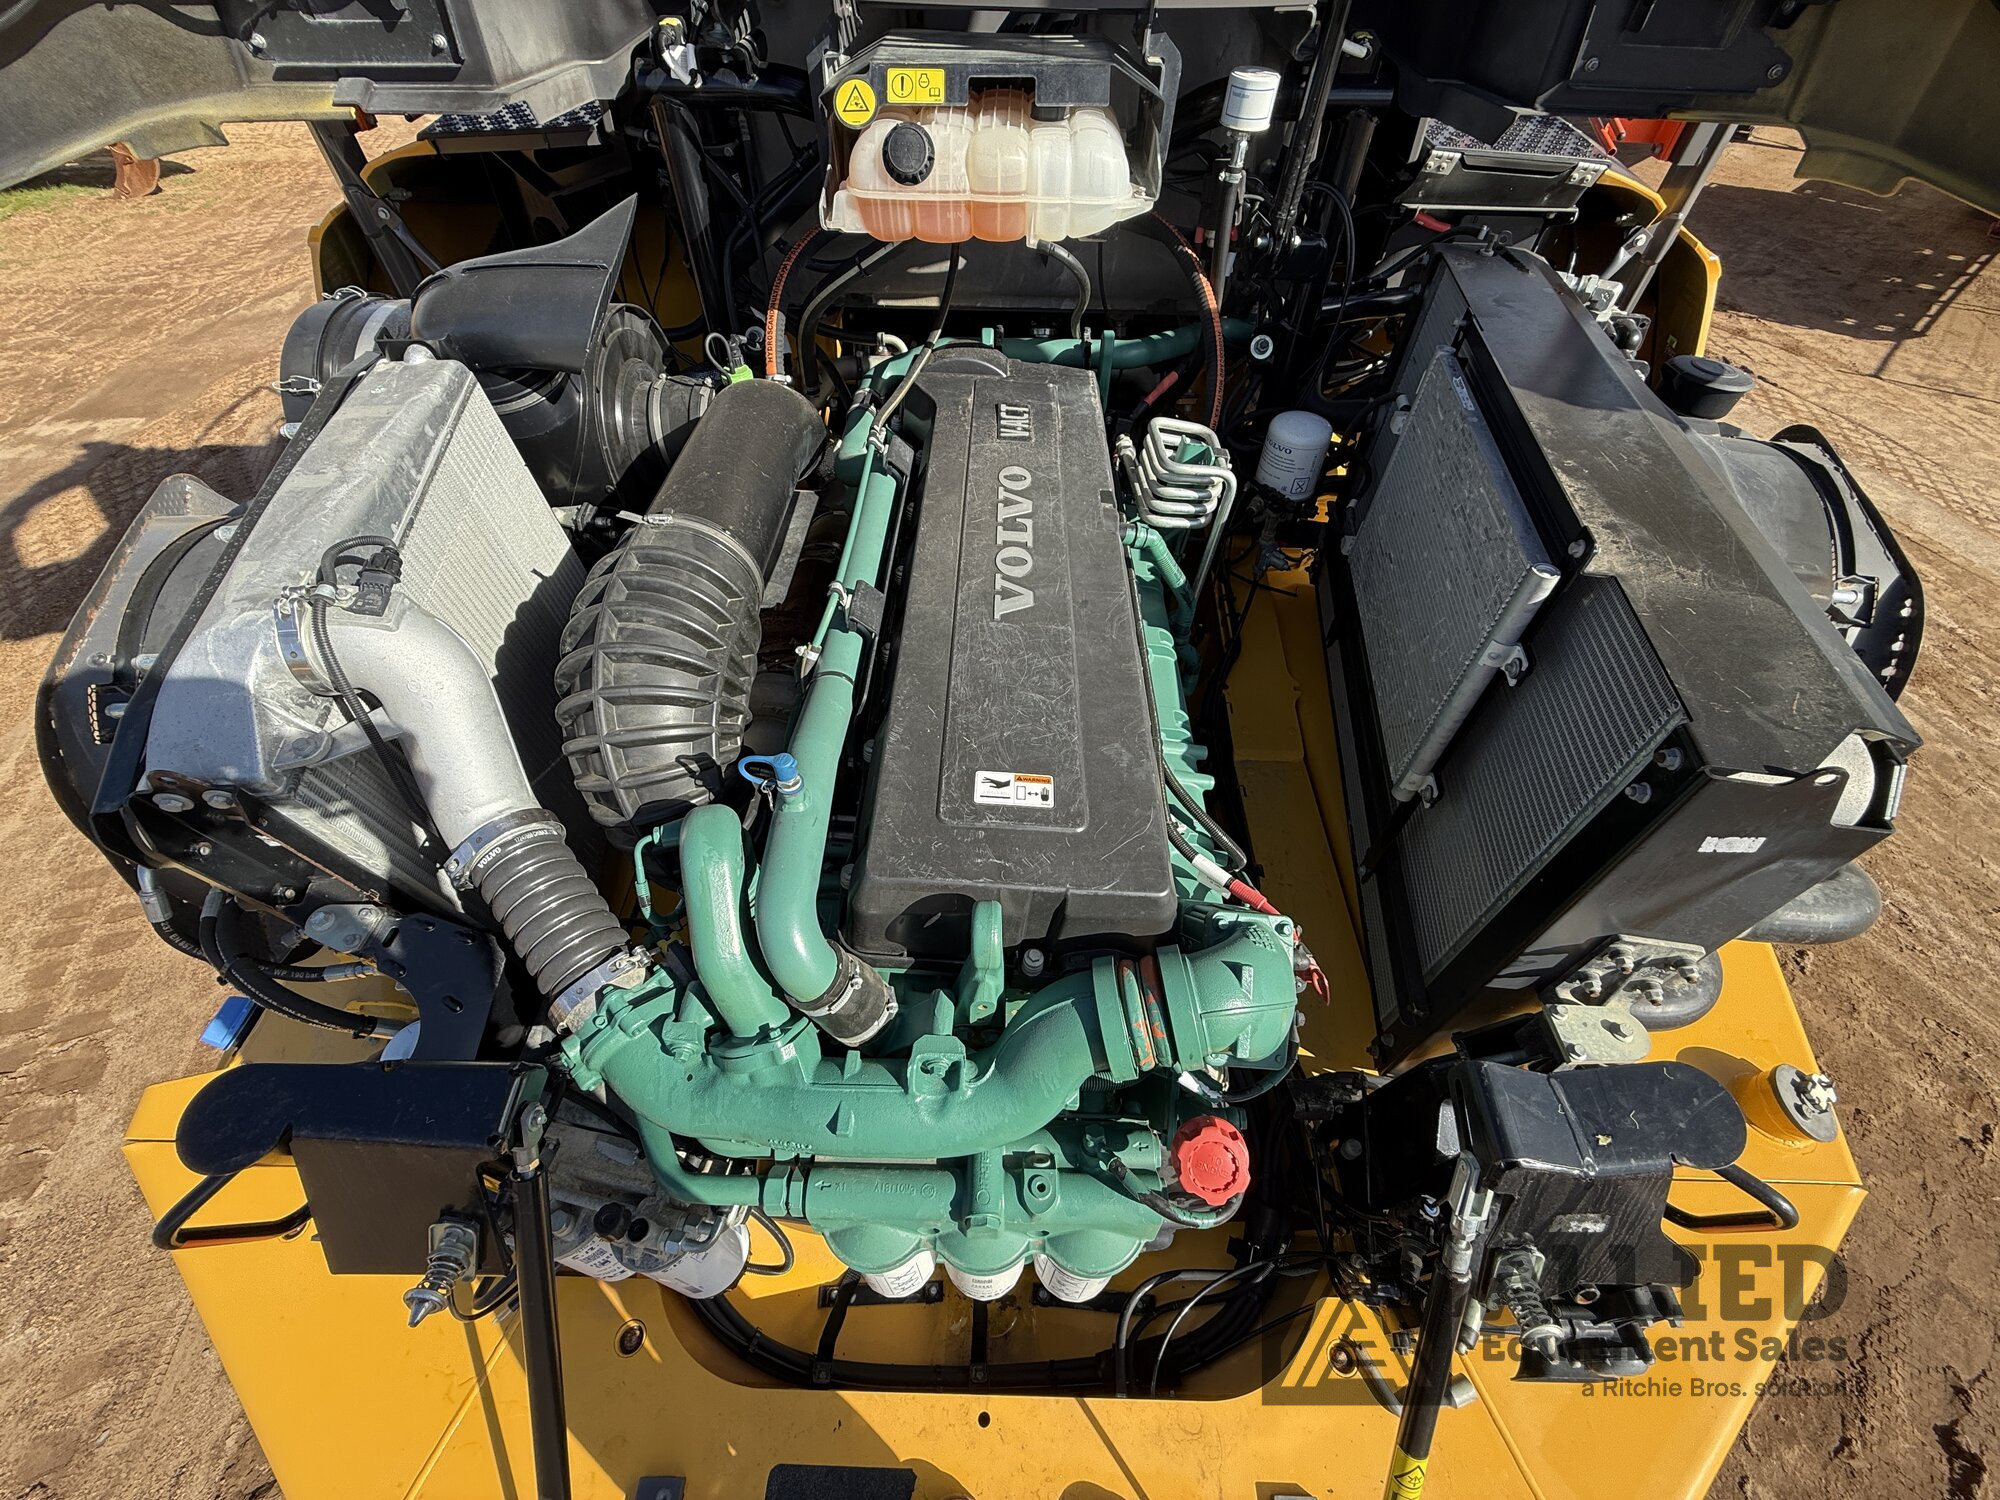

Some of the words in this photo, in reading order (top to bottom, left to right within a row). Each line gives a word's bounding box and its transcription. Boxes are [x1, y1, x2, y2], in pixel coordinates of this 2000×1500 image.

[767, 309, 775, 363] HYDROSCAND
[1266, 437, 1292, 455] VOLVO
[994, 465, 1034, 620] VOLVO
[477, 846, 502, 869] VOLVO
[1195, 1161, 1229, 1178] ENGINE
